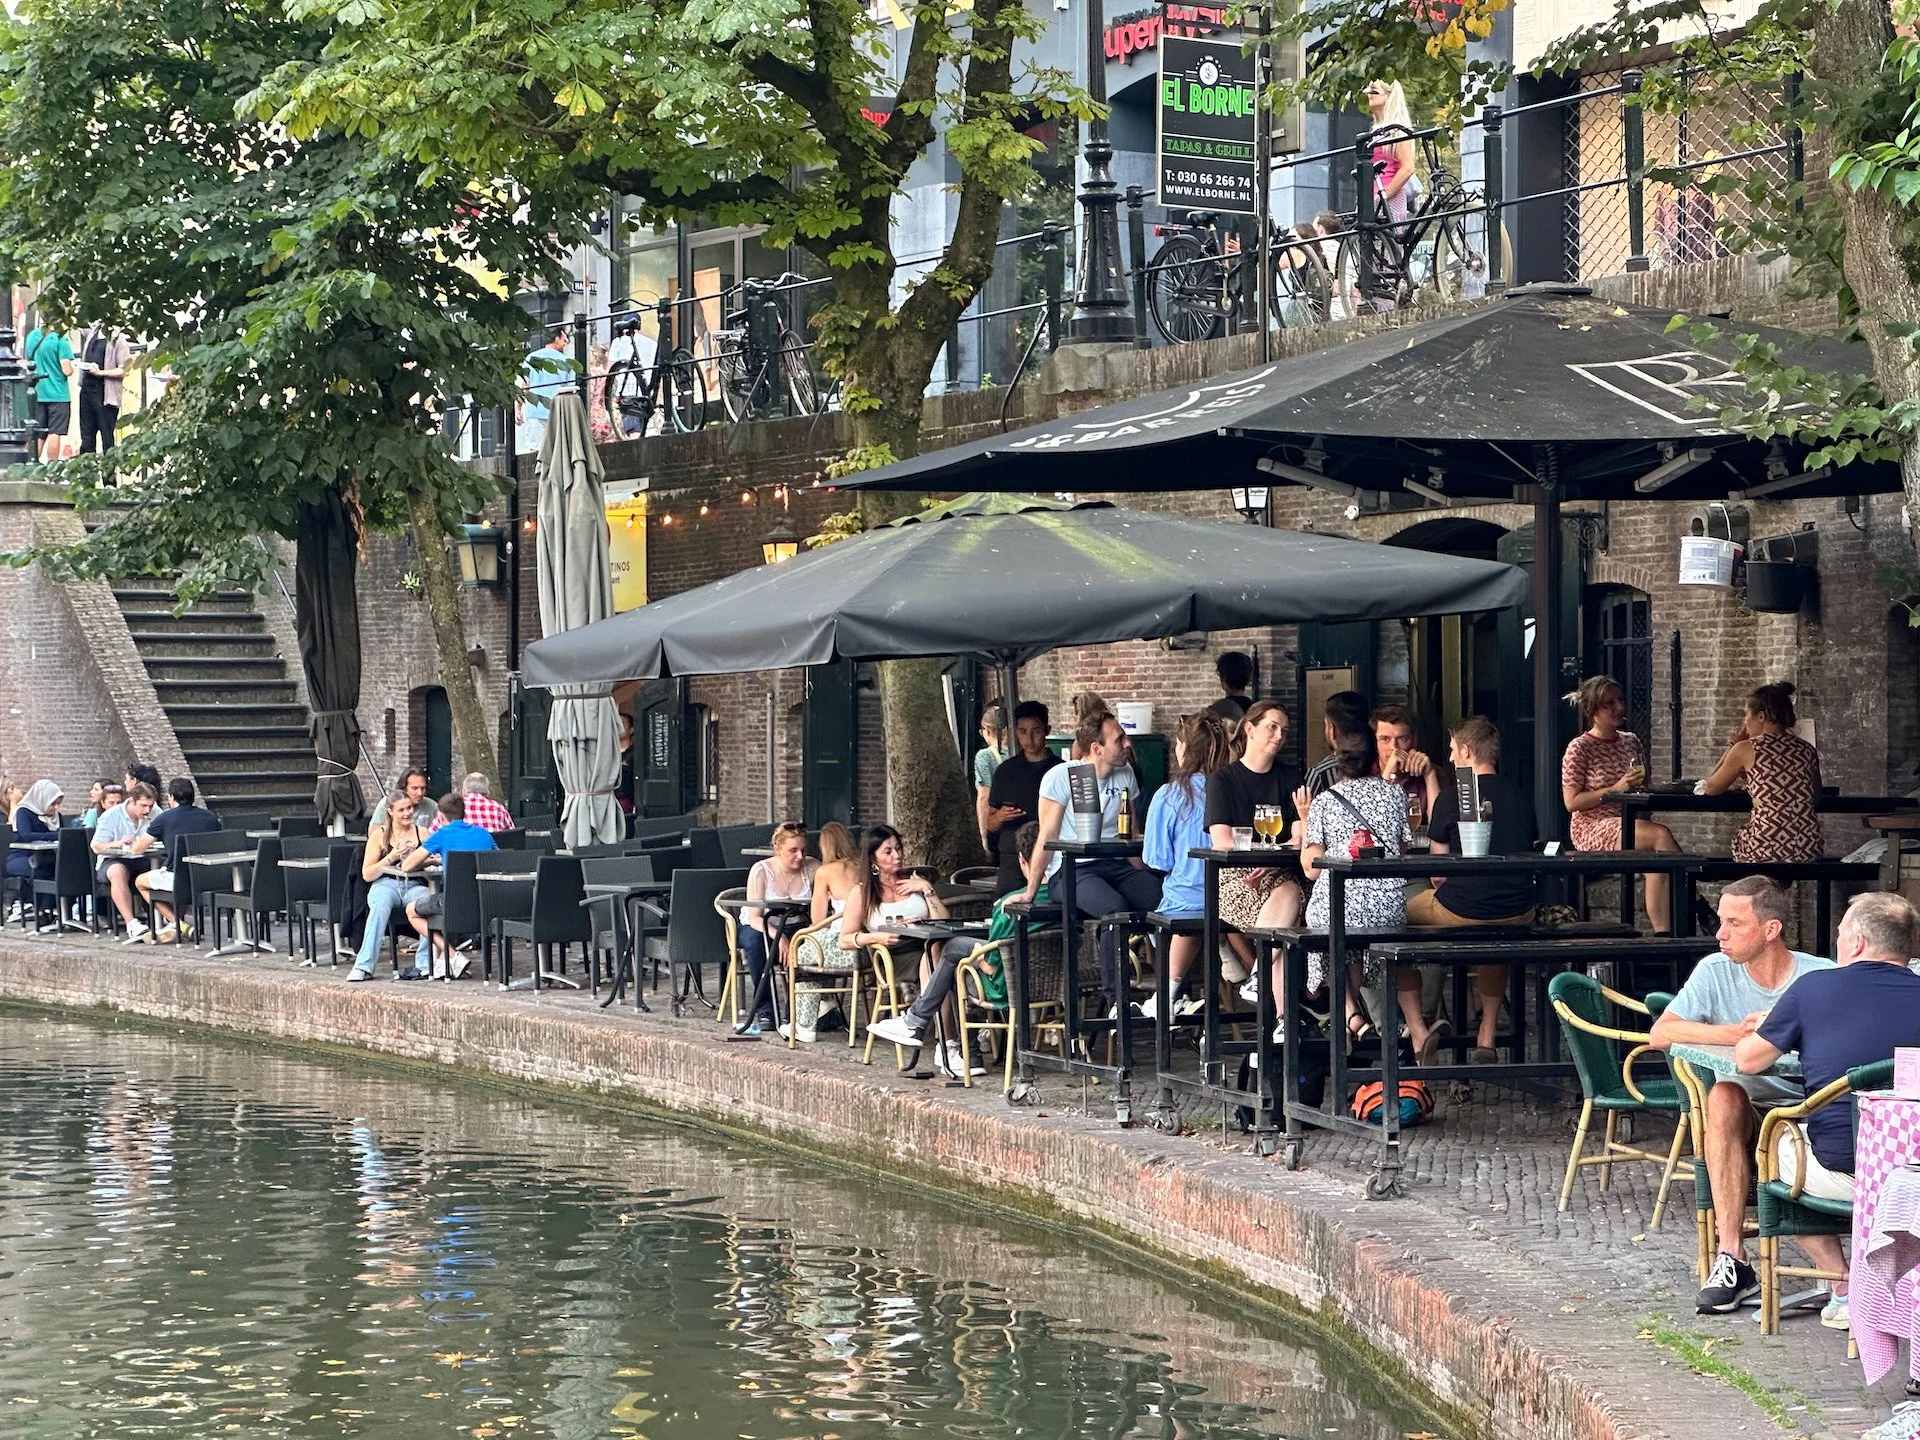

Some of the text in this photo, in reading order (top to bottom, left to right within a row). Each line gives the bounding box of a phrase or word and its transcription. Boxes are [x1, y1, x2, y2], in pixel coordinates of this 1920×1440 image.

[1163, 78, 1255, 118] EL BORNE
[1165, 139, 1253, 158] TAPAS & GRILL
[1165, 169, 1251, 188] T: 030 66 266 74
[1165, 185, 1252, 201] WWW.ELBORNE.NL
